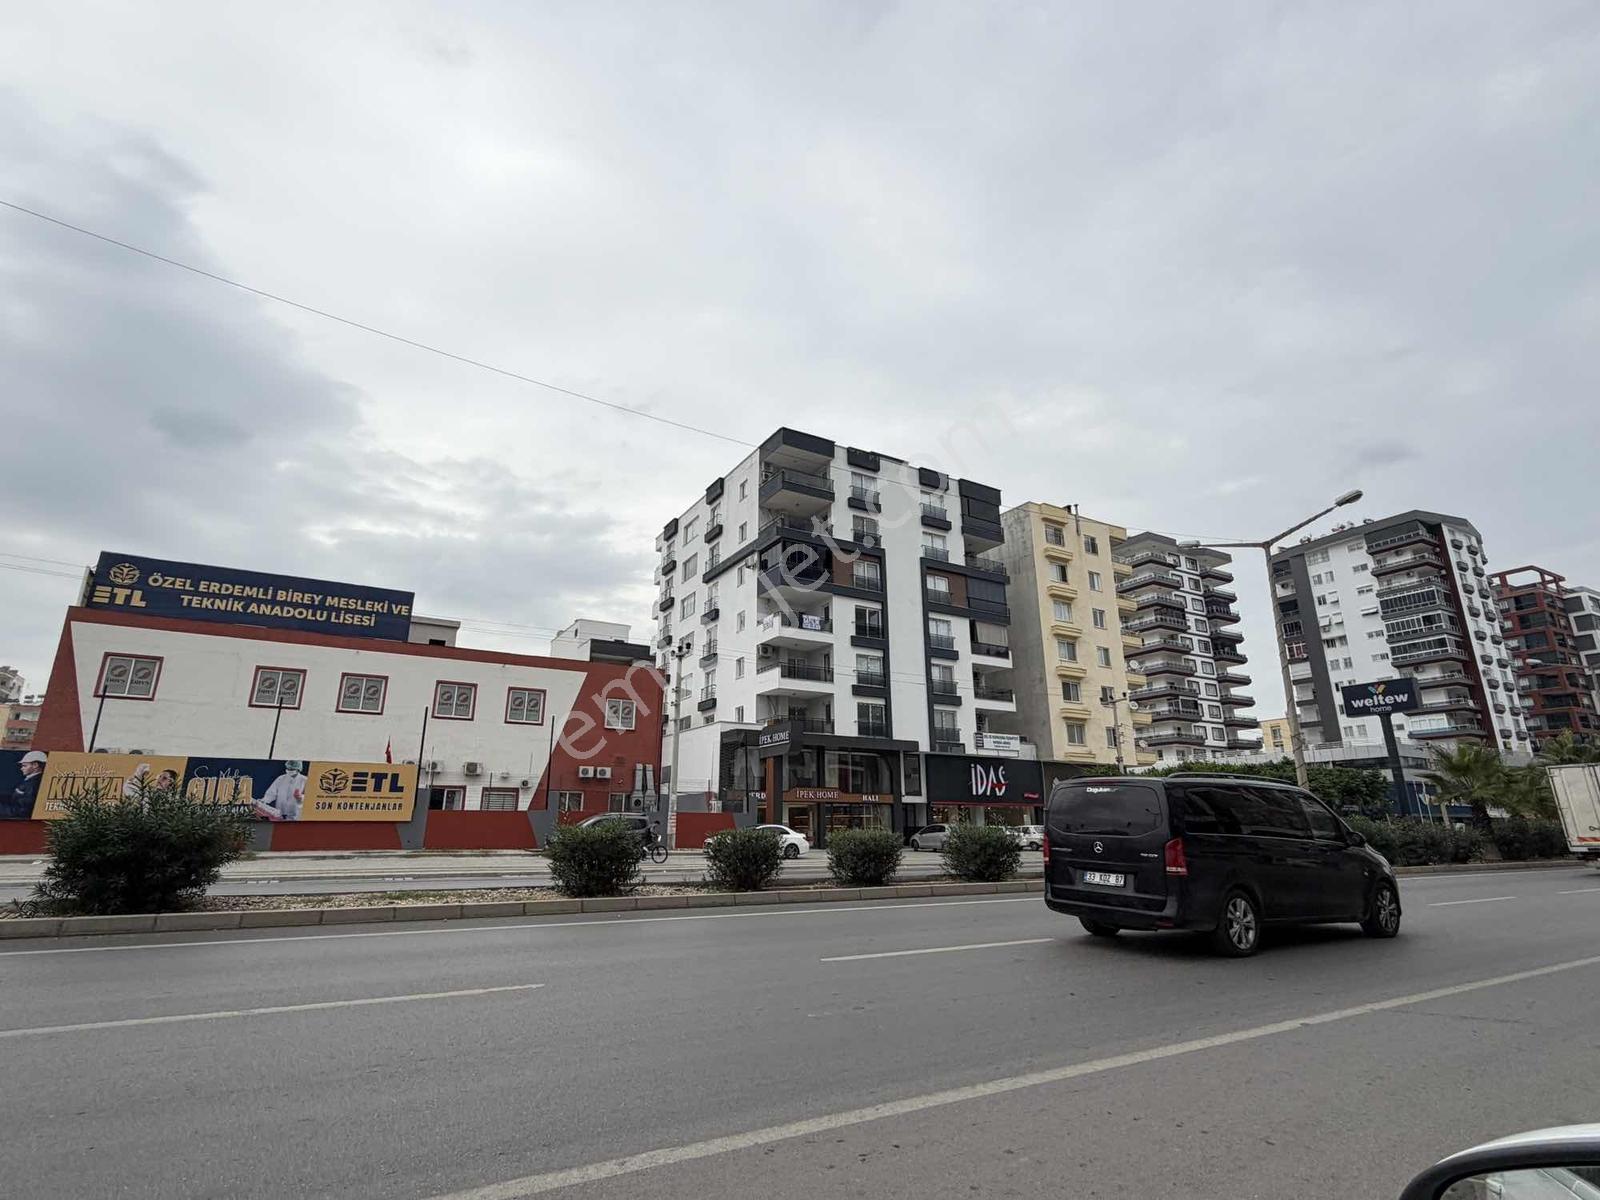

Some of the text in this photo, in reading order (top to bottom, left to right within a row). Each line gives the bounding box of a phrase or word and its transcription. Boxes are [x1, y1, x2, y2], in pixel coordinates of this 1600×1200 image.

[91, 585, 147, 608] ETL
[148, 572, 409, 616] ÖZEL ERDEMLİ BİREY MESLEKİ VE
[180, 594, 376, 627] TEKNİK ANADOLU LİSESİ
[1352, 693, 1408, 708] weltew
[1370, 705, 1392, 713] home
[772, 731, 790, 742] HOME
[351, 771, 405, 793] ETL
[816, 790, 839, 800] HOME
[315, 801, 403, 811] SON KONTENJANLAR
[1087, 872, 1096, 881] 33
